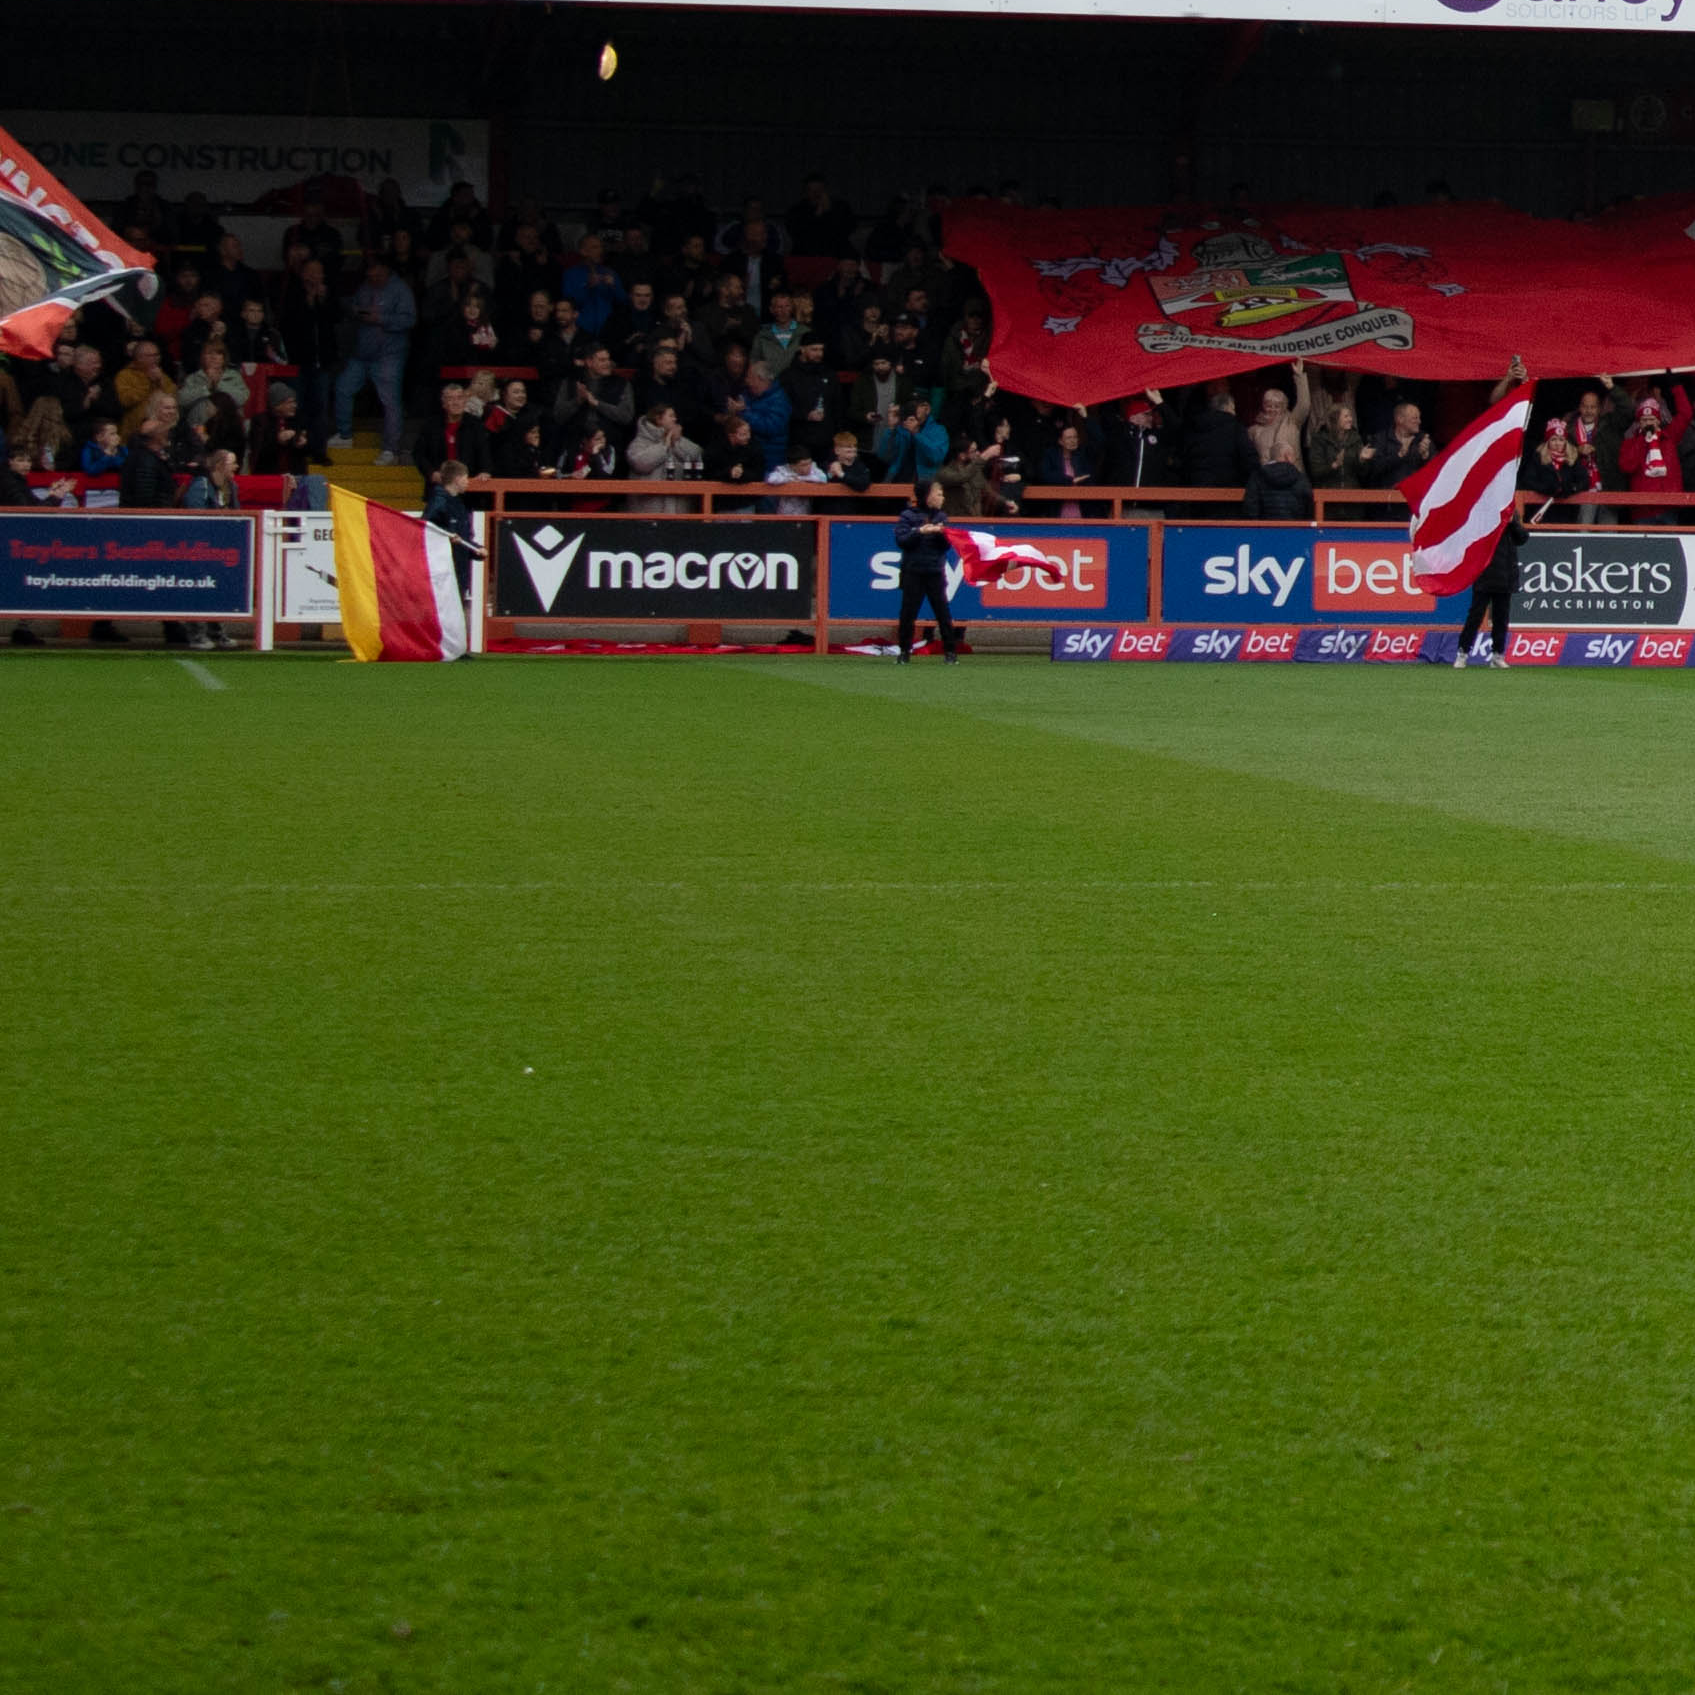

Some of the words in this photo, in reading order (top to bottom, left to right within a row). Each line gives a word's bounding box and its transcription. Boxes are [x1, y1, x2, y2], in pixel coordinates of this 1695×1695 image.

[117, 142, 393, 173] CONSTRUCTION
[1259, 333, 1334, 354] PRUDENCE
[1335, 313, 1401, 341] CONQUER
[9, 540, 98, 562] Taylors
[105, 540, 240, 567] Scaffolding
[25, 574, 216, 590] taylorsscaffoldingltd.co.uk
[588, 551, 799, 590] macron
[870, 551, 964, 603] sy
[1203, 545, 1305, 607] sky
[1327, 548, 1423, 595] bet
[1518, 547, 1672, 595] taskers
[1522, 597, 1537, 610] of
[1540, 599, 1655, 610] ACCRINGTON
[1065, 628, 1113, 656] sky
[1117, 631, 1166, 654] bet
[1193, 629, 1241, 659] sky
[1246, 631, 1294, 654] bet
[1318, 629, 1368, 659] sky
[1371, 631, 1420, 654] bet
[1512, 633, 1560, 657] bet
[1585, 634, 1635, 663] sky
[1639, 636, 1687, 659] bet
